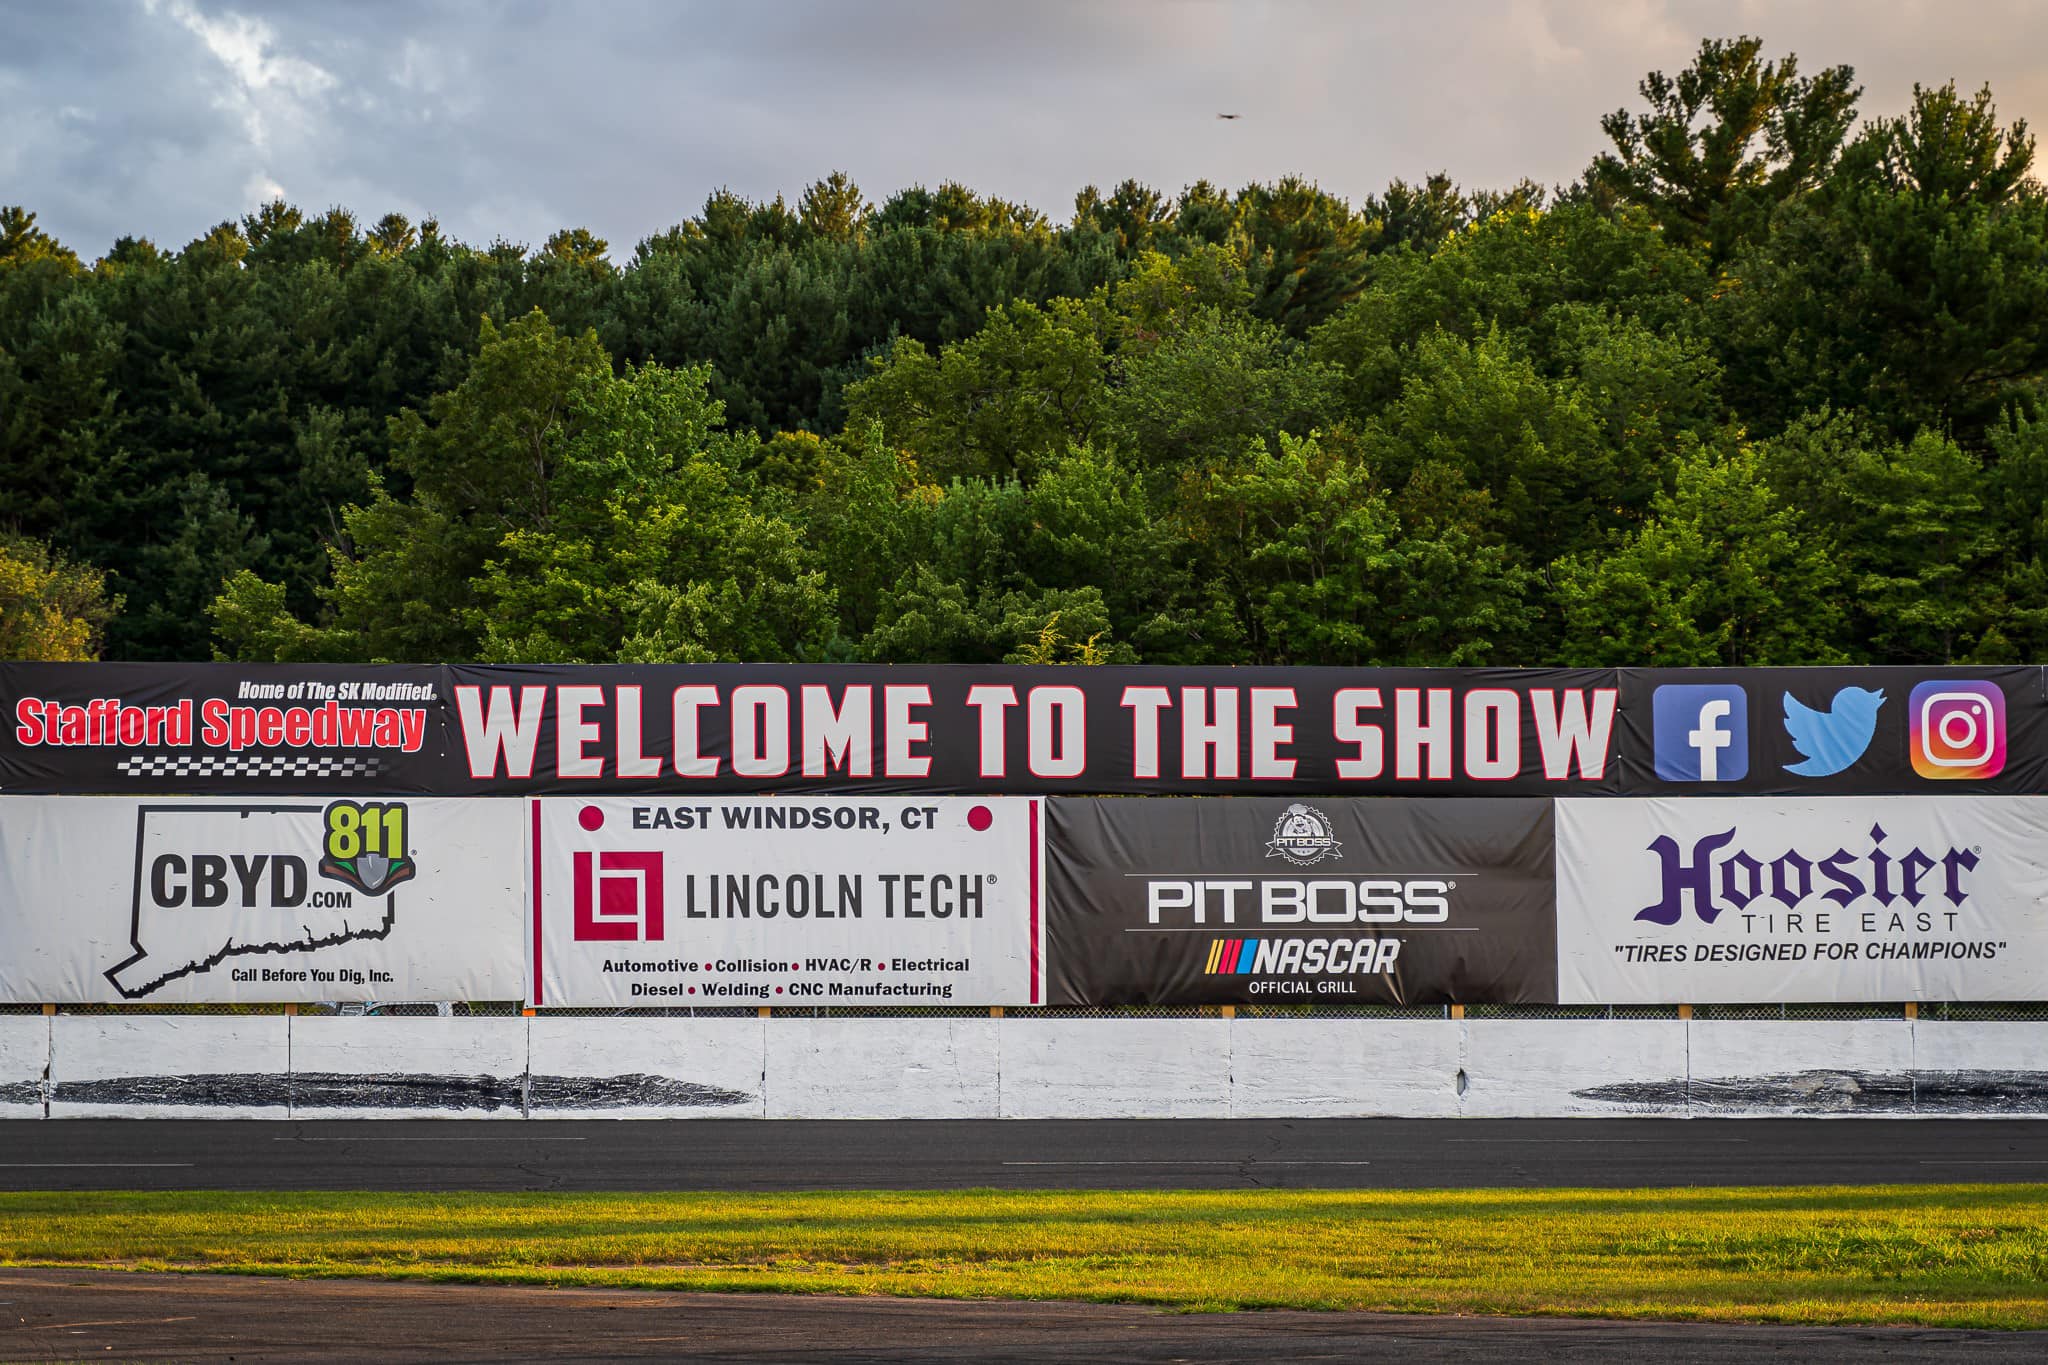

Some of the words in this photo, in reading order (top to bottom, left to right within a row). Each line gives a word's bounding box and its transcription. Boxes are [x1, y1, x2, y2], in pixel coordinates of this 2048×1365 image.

[238, 681, 284, 699] Home
[287, 682, 304, 699] of
[306, 682, 335, 699] The
[338, 683, 360, 700] SK
[16, 697, 193, 746] Stafford
[201, 698, 426, 752] Speedway
[454, 685, 933, 779] WELCOME
[966, 685, 1086, 778] TO
[1120, 687, 1298, 780] THE
[1333, 688, 1617, 780] SHOW
[328, 805, 402, 859] 811
[632, 807, 712, 829] EAST
[721, 807, 890, 835] WINDSOR,
[900, 807, 938, 829] CT
[1276, 837, 1296, 847] PIT
[1296, 837, 1331, 847] BOSS
[686, 874, 863, 918] LINCOLN
[1148, 881, 1252, 924] PIT
[1741, 913, 1831, 934] TIRE
[1861, 911, 1959, 933] EAST
[1615, 945, 1687, 962] "TIRES
[1694, 943, 1807, 961] DESIGNED
[1813, 943, 1859, 960] FOR
[1865, 941, 2007, 960] CHAMPIONS"
[231, 968, 257, 982] Call
[262, 968, 307, 982] Before
[310, 969, 335, 982] You
[339, 969, 365, 984] Dig,
[369, 969, 394, 982] Inc.
[602, 959, 699, 973] Automotive
[715, 959, 788, 973] Collision
[805, 958, 872, 974] HVAC/R
[891, 958, 969, 972] Electrical
[631, 983, 684, 996] Diesel
[701, 983, 770, 999] Welding
[788, 983, 824, 996] CNC
[828, 982, 953, 998] Manufacturing
[1249, 981, 1313, 994] OFFICIAL
[1317, 981, 1357, 994] GRILL
